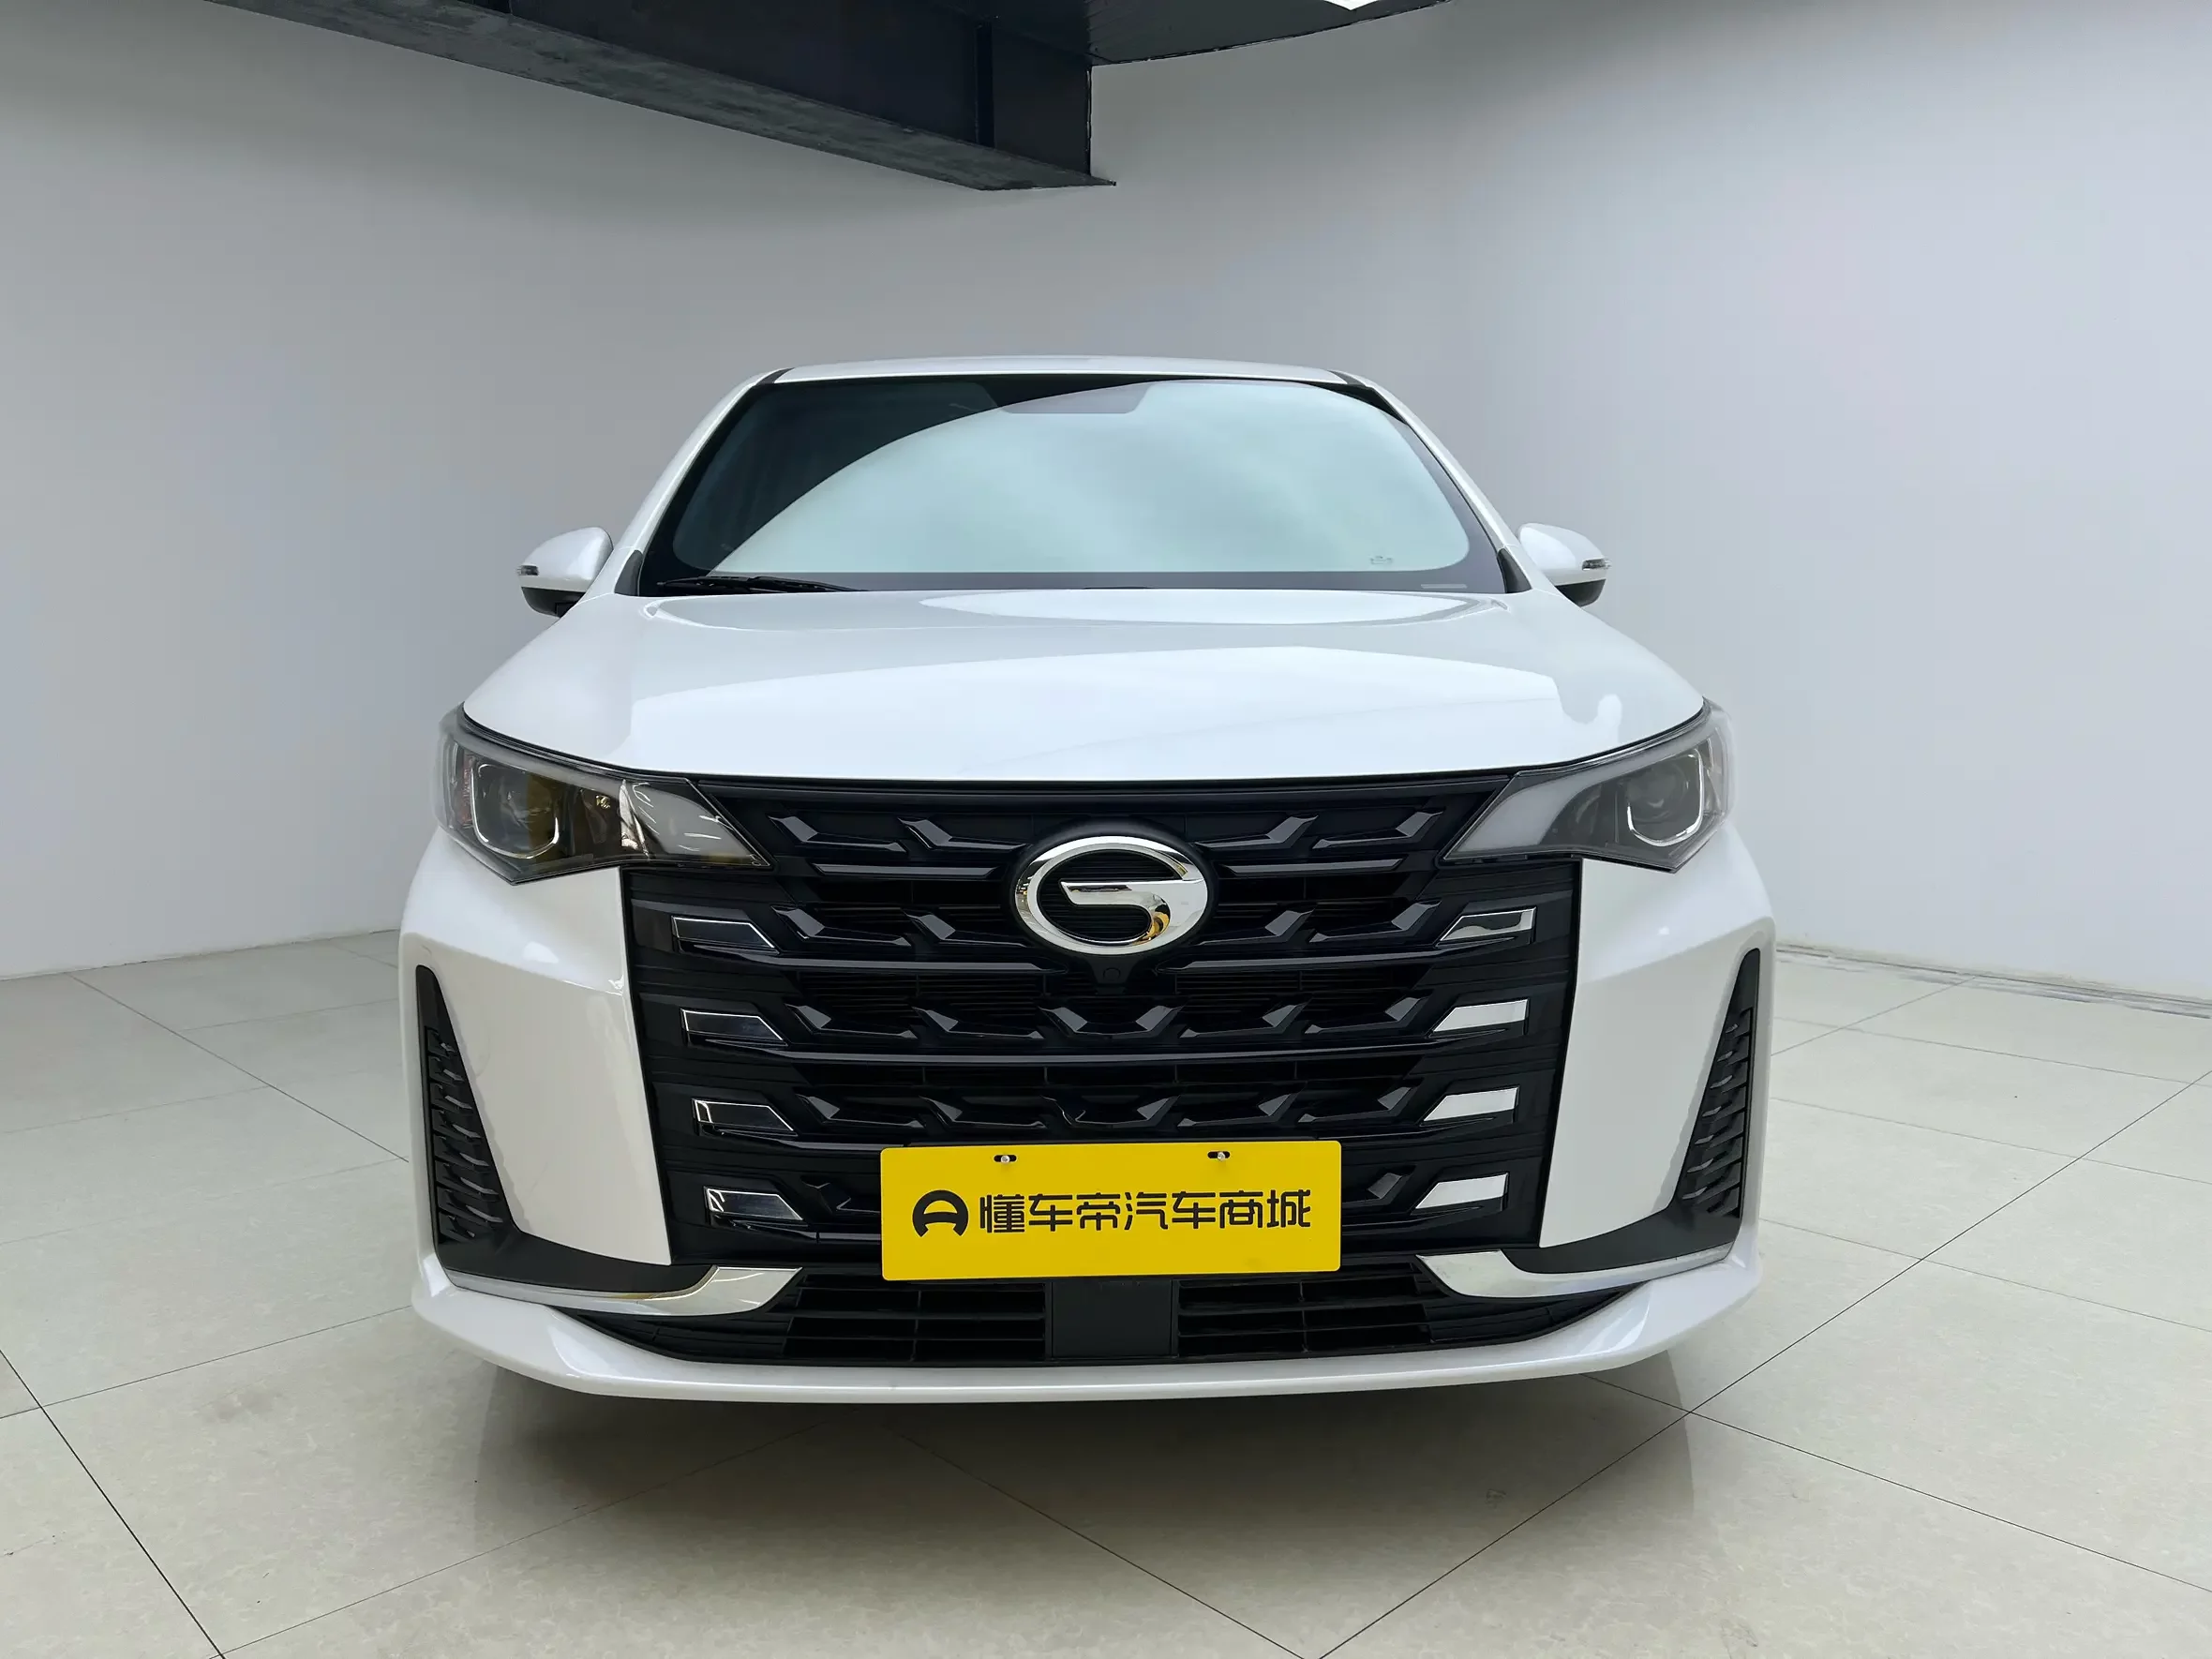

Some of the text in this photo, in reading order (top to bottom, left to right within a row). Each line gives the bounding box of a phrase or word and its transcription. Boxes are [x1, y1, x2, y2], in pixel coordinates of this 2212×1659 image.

[979, 1188, 1311, 1233] 懂车帝汽车商城
